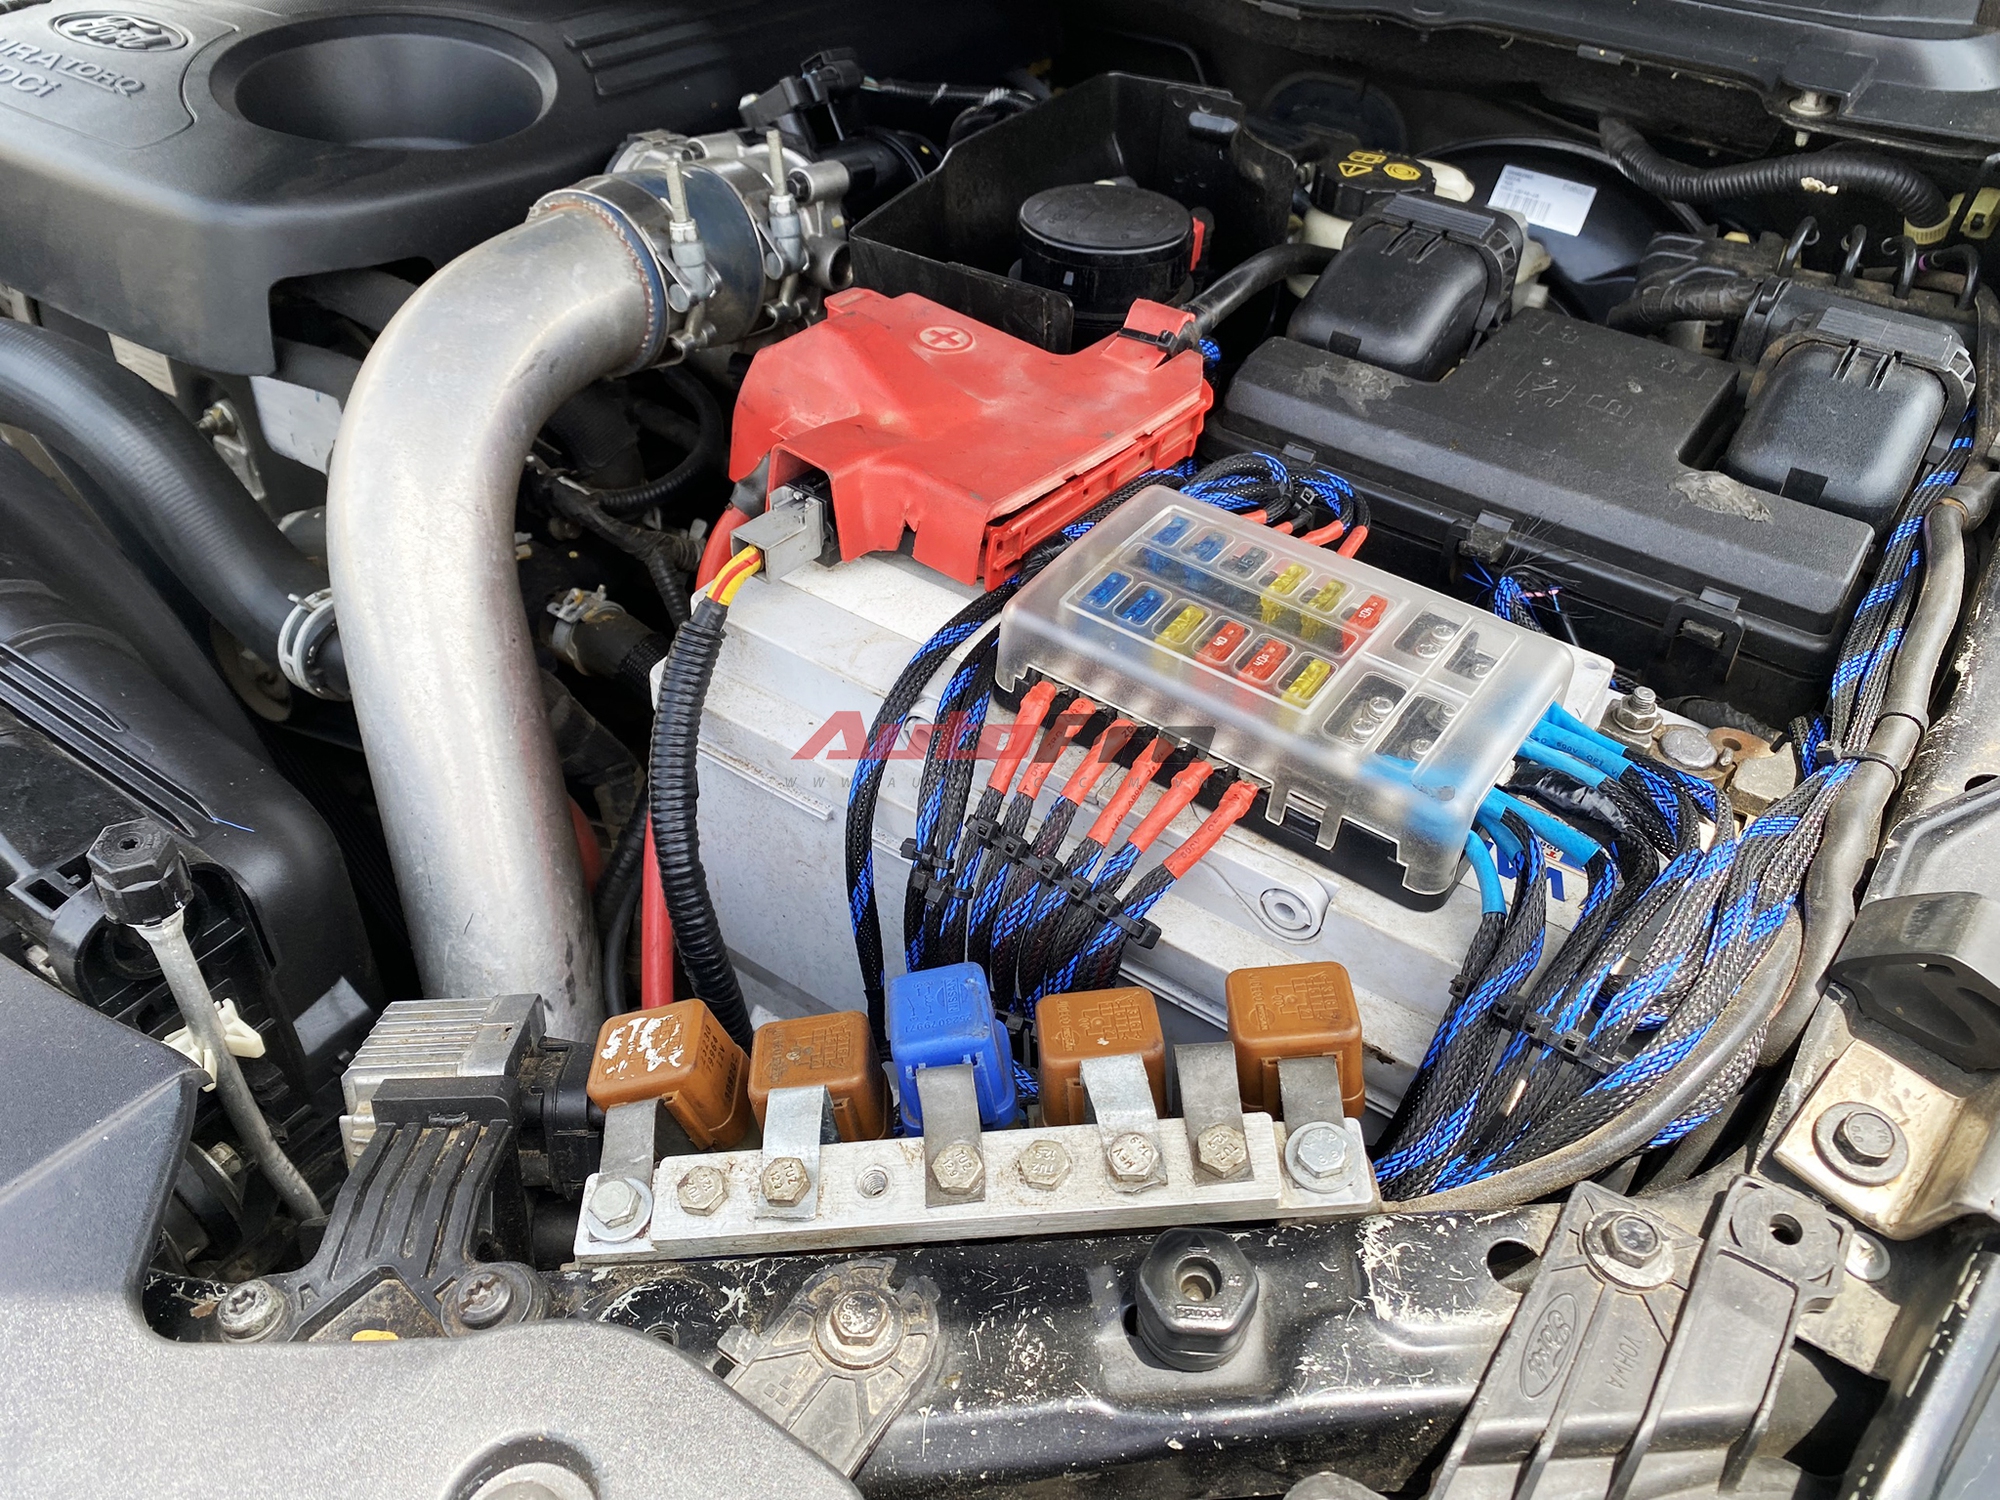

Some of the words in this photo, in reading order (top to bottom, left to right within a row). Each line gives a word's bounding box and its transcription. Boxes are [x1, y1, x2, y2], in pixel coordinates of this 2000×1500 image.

[67, 14, 171, 50] Ford
[1237, 556, 1255, 569] 15
[946, 979, 961, 1013] NISSAN
[1129, 1136, 1149, 1157] 12.9
[1215, 1143, 1239, 1162] TUZ
[942, 1158, 959, 1178] 12.9
[955, 1150, 973, 1172] TUZ
[784, 1162, 798, 1185] TUZ
[1528, 1309, 1573, 1383] Ford
